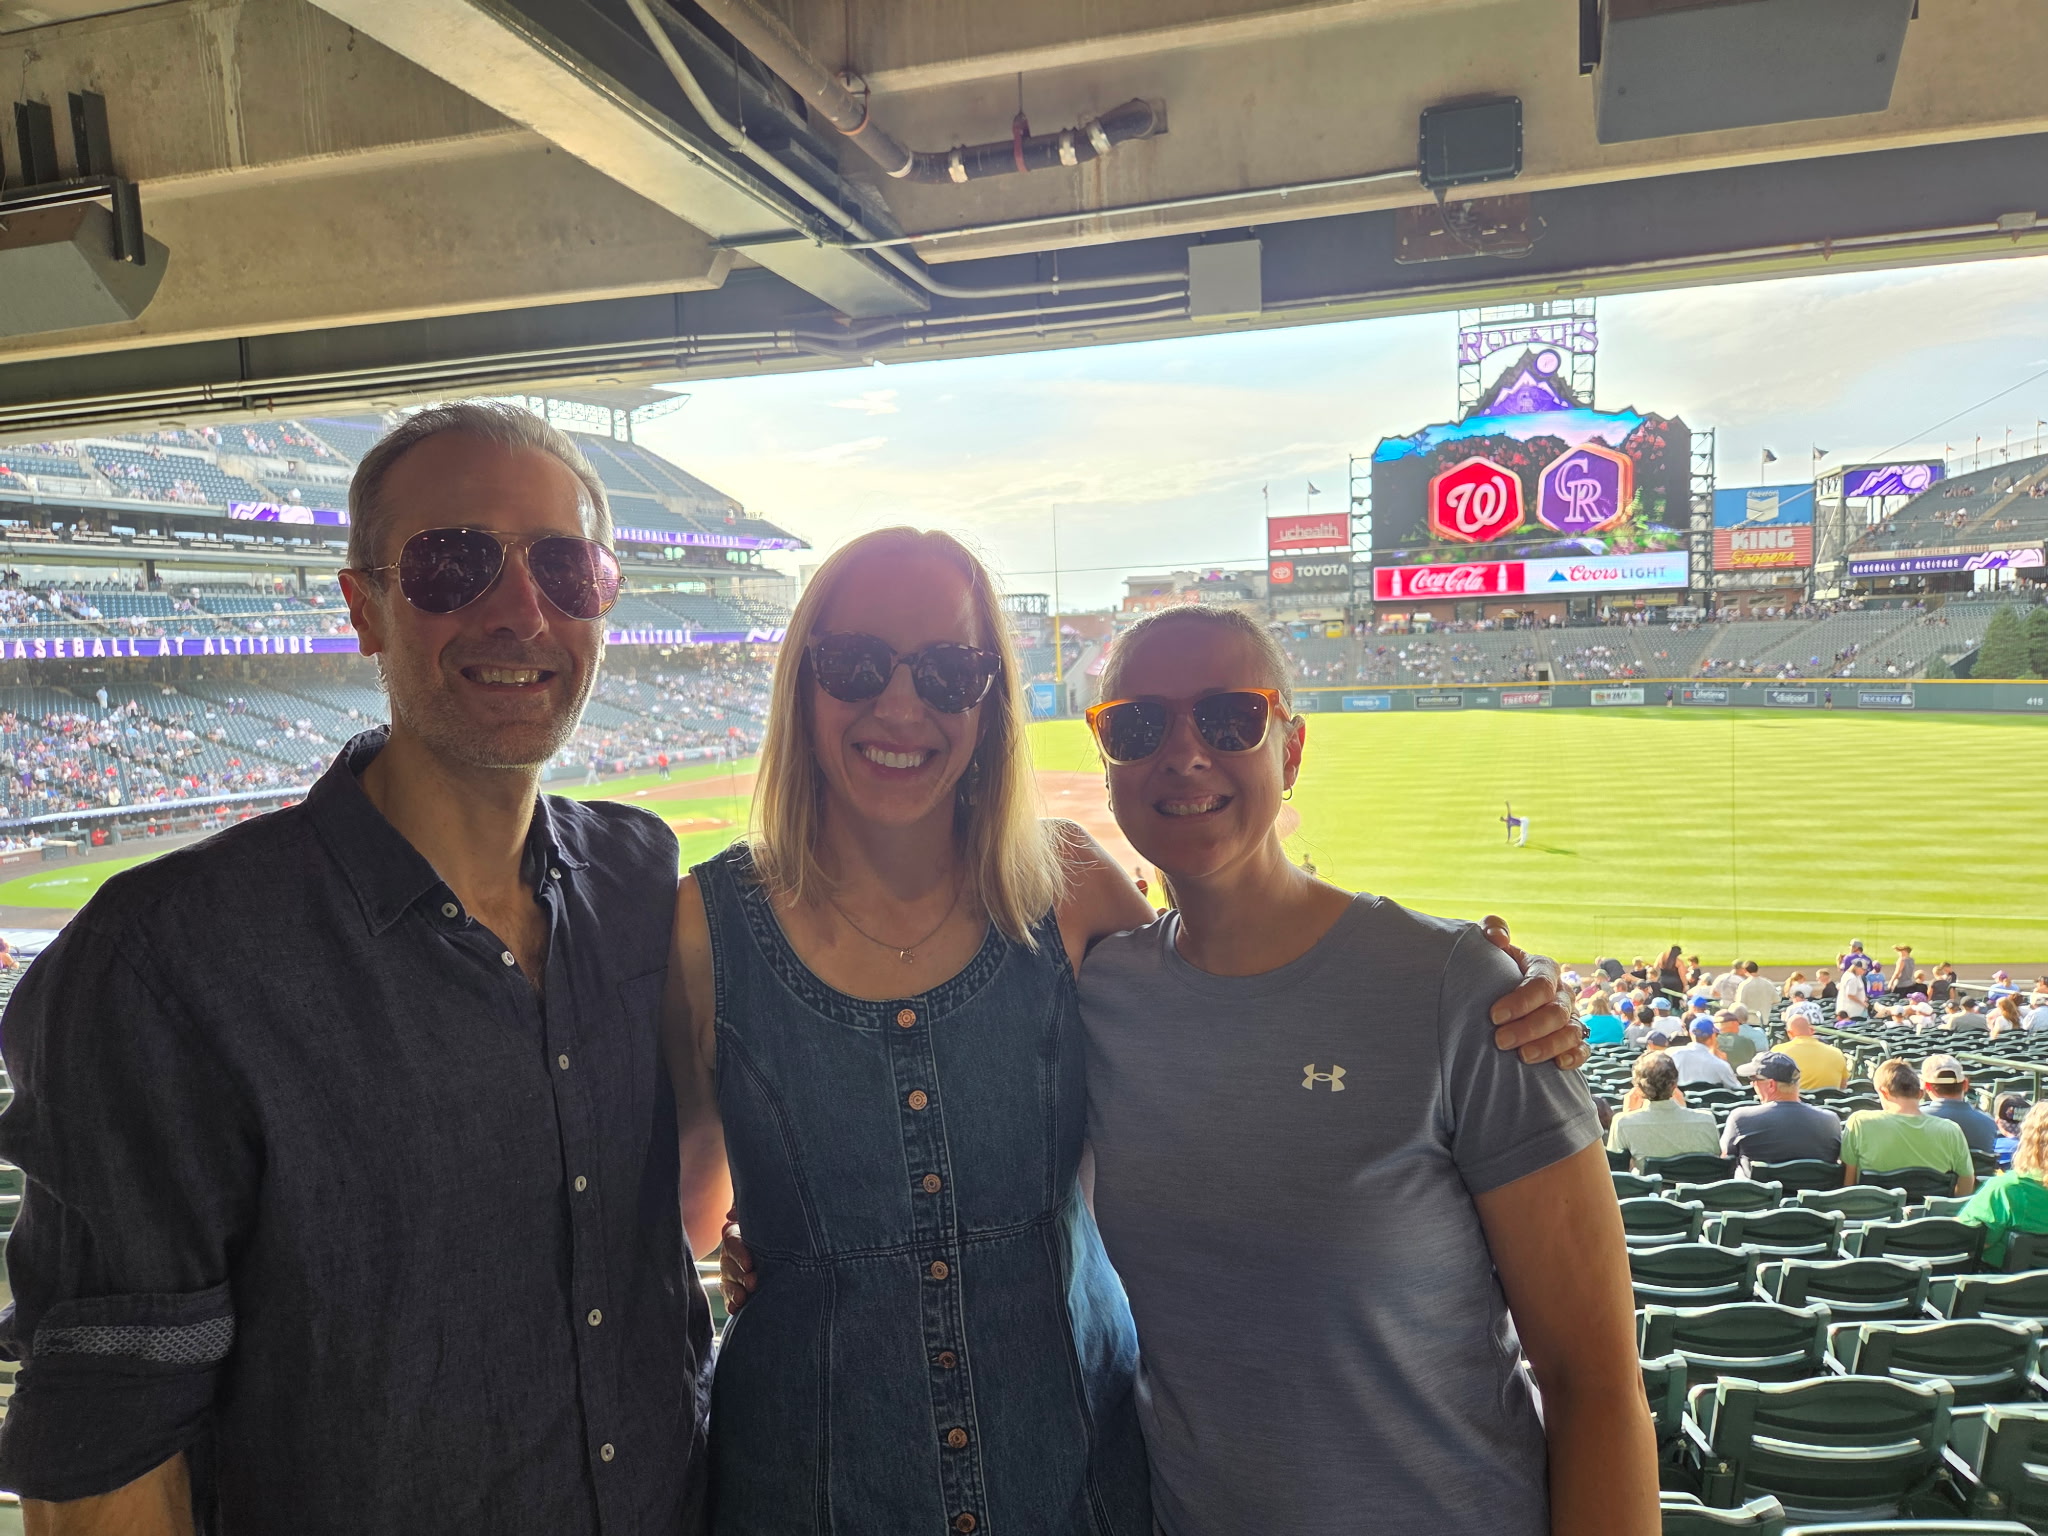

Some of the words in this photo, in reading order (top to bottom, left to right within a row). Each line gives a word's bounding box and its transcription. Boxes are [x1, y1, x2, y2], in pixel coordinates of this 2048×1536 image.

[1279, 522, 1340, 542] uchealth
[1730, 529, 1795, 551] KING
[1729, 549, 1796, 567] Soopers
[1295, 563, 1348, 578] TOYOTA
[1568, 565, 1618, 583] Coors
[1621, 565, 1666, 579] LIGHT
[1852, 562, 1896, 574] BASEBALL
[1199, 590, 1241, 602] TUNDRA
[159, 637, 185, 657] AT
[203, 635, 314, 656] ALTITUDE
[2026, 697, 2044, 706] 415
